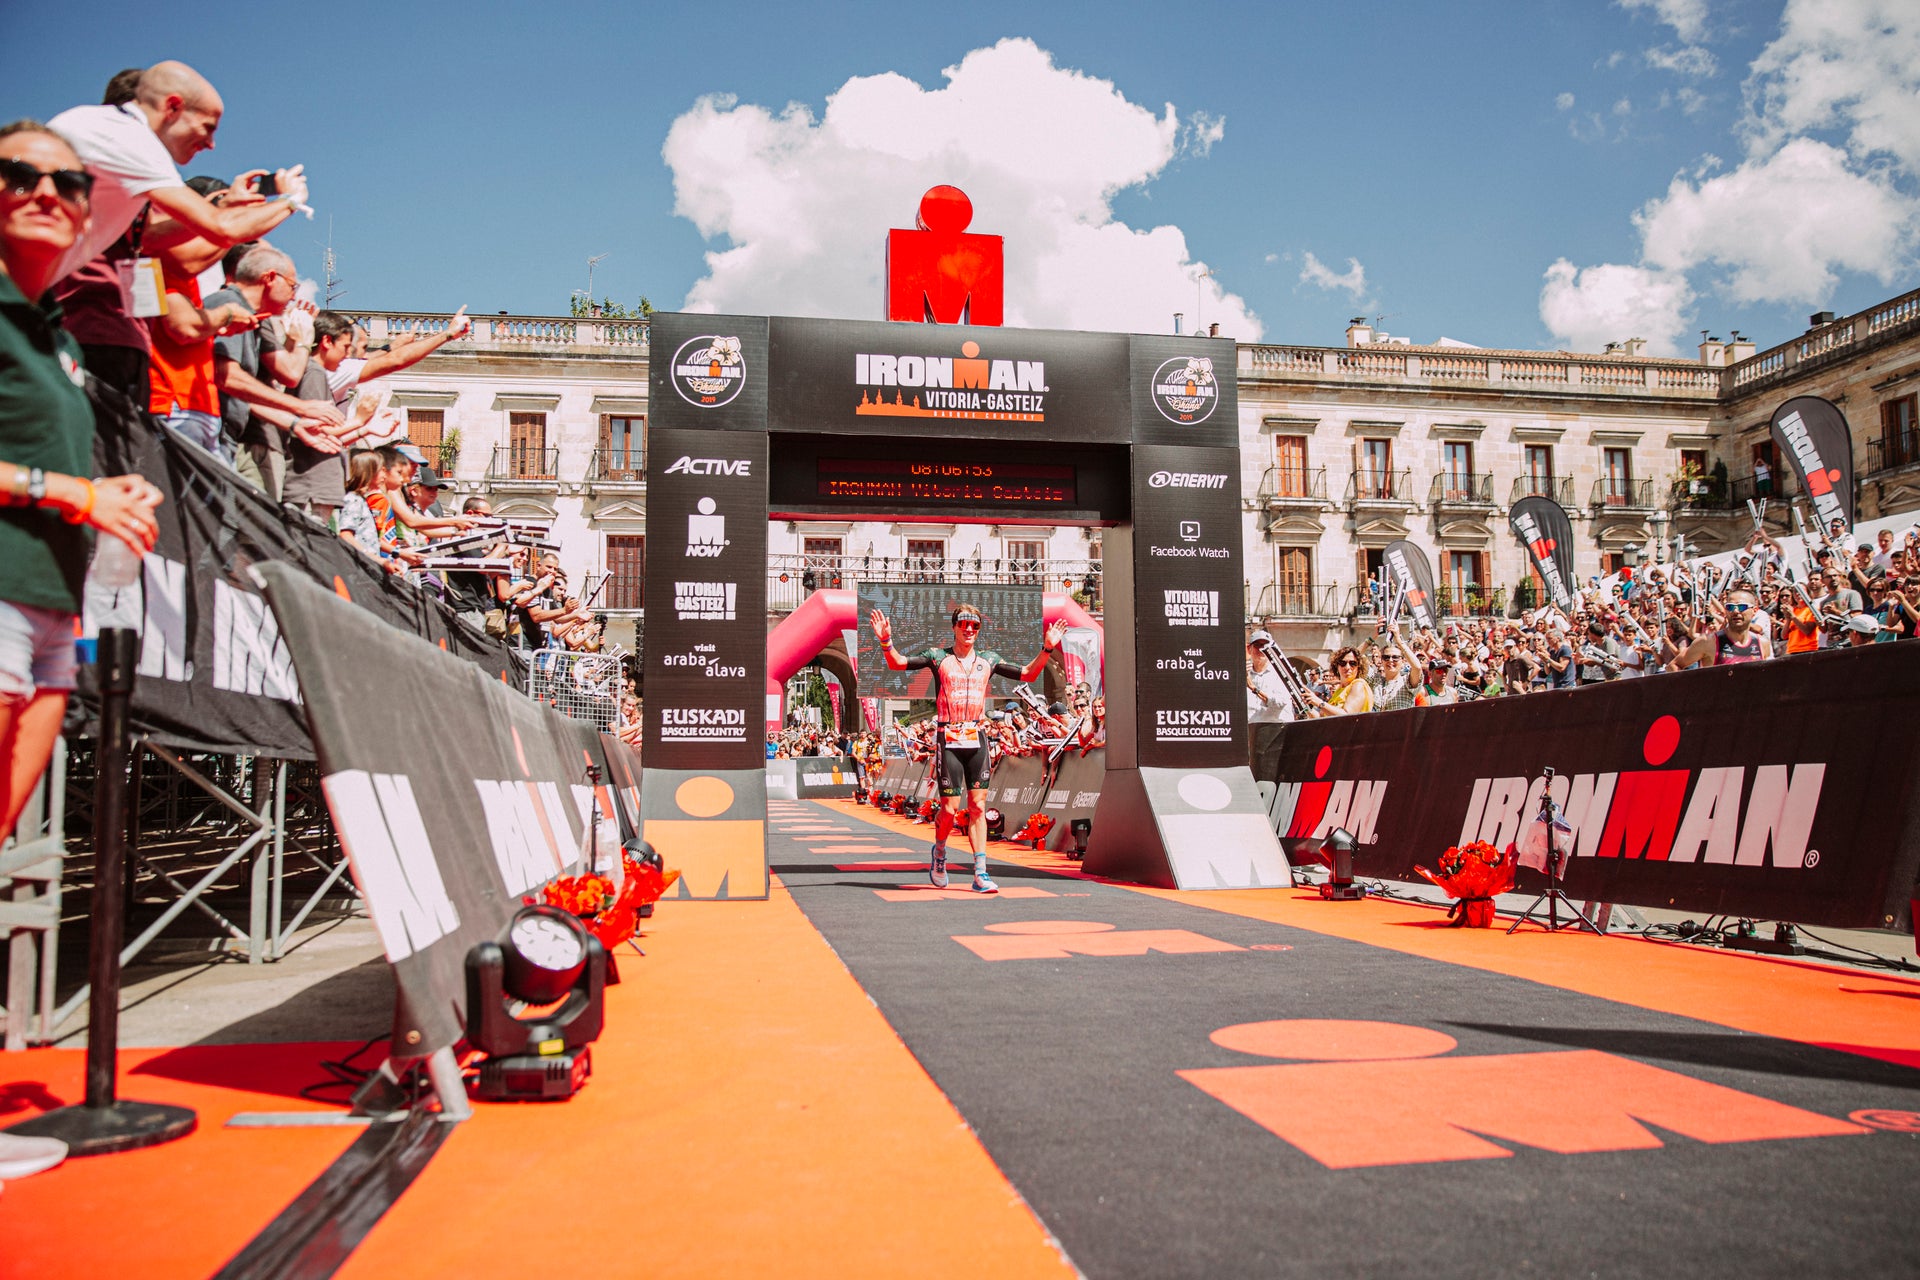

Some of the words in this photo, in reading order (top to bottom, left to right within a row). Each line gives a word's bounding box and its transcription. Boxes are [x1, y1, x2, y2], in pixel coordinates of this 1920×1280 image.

[925, 391, 1044, 412] VITORIA-GASTEIZ
[1179, 413, 1193, 421] 2019
[663, 455, 752, 476] ACTIVE
[1170, 472, 1228, 489] ENERVIT
[685, 545, 725, 558] NOW
[1150, 546, 1197, 558] Facebook
[1198, 547, 1230, 559] Watch
[674, 581, 725, 597] VITORIA
[1164, 590, 1209, 604] VITORIA
[694, 643, 716, 653] visit
[1183, 648, 1203, 657] visit
[663, 652, 707, 666] araba
[1156, 656, 1195, 670] araba
[661, 708, 746, 725] EUSKADI
[1156, 710, 1231, 725] EUSKADI
[661, 727, 698, 737] BASQUE
[698, 727, 747, 736] COUNTRY
[1156, 727, 1189, 737] BASQUE
[1189, 727, 1232, 736] COUNTRY
